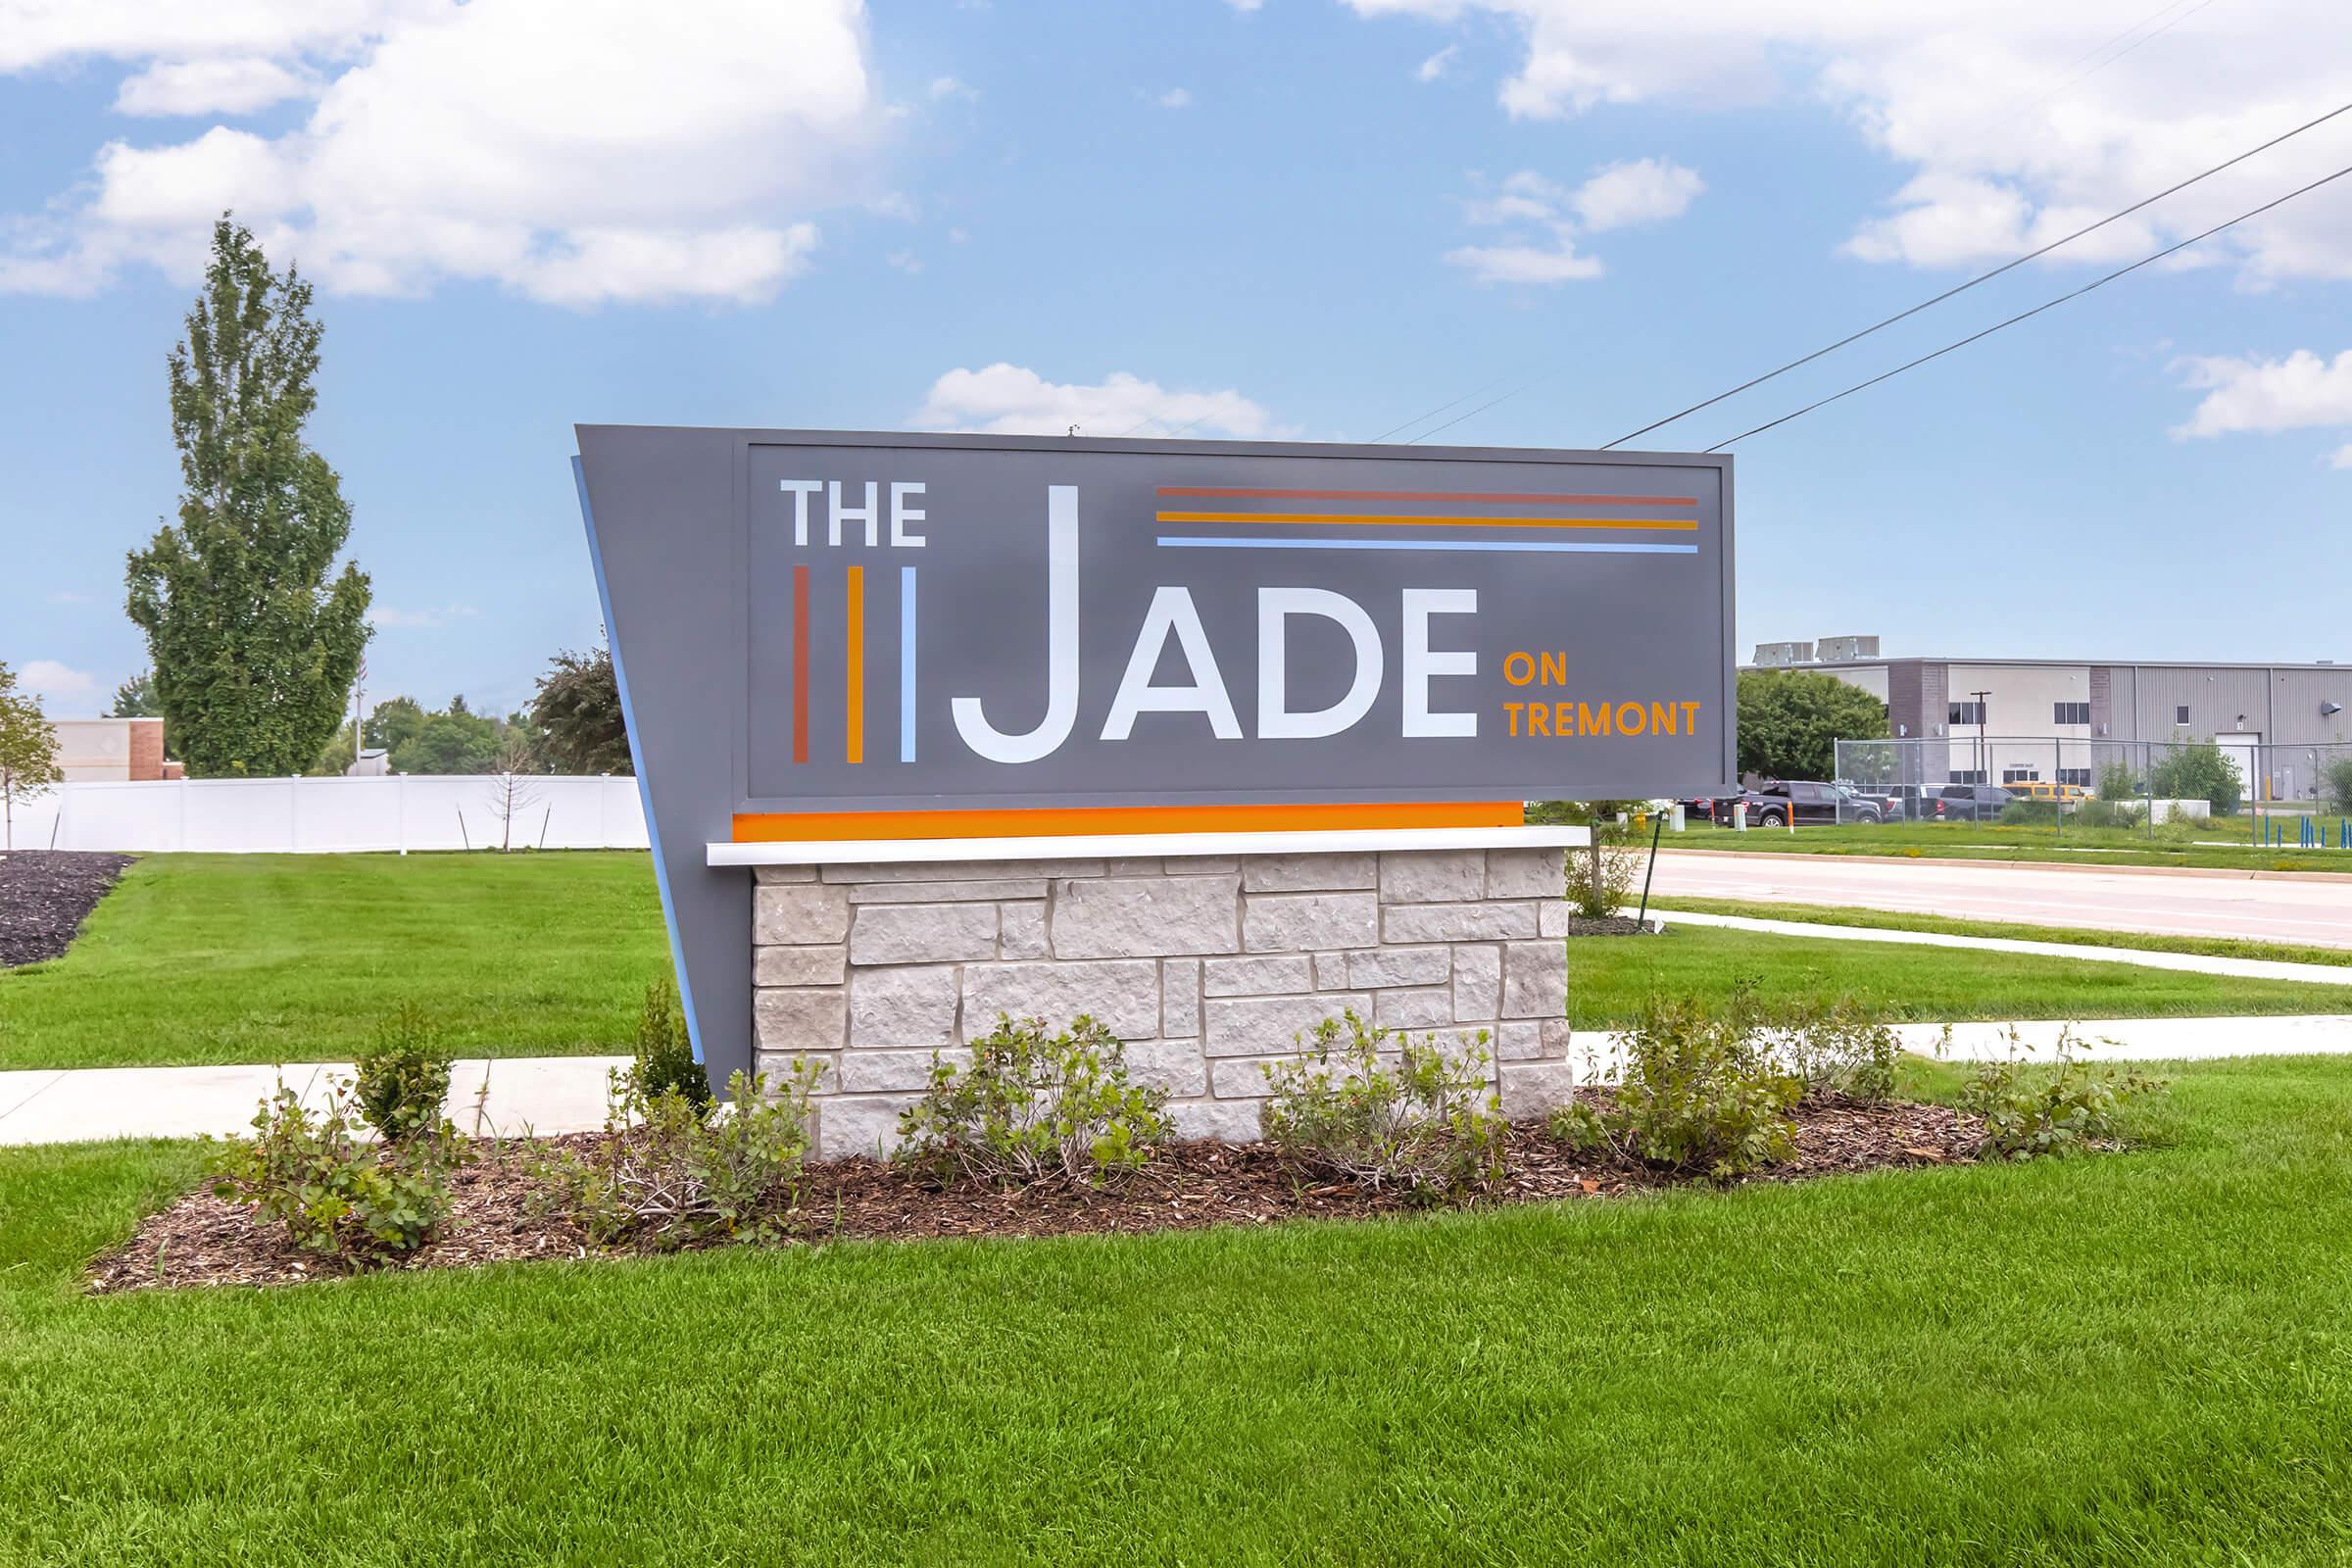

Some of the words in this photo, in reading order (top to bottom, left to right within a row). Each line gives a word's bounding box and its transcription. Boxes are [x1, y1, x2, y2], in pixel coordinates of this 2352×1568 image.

[779, 479, 927, 548] THE
[951, 484, 1479, 764] JADE
[1502, 651, 1568, 687] ON
[1502, 701, 1701, 738] TREMONT
